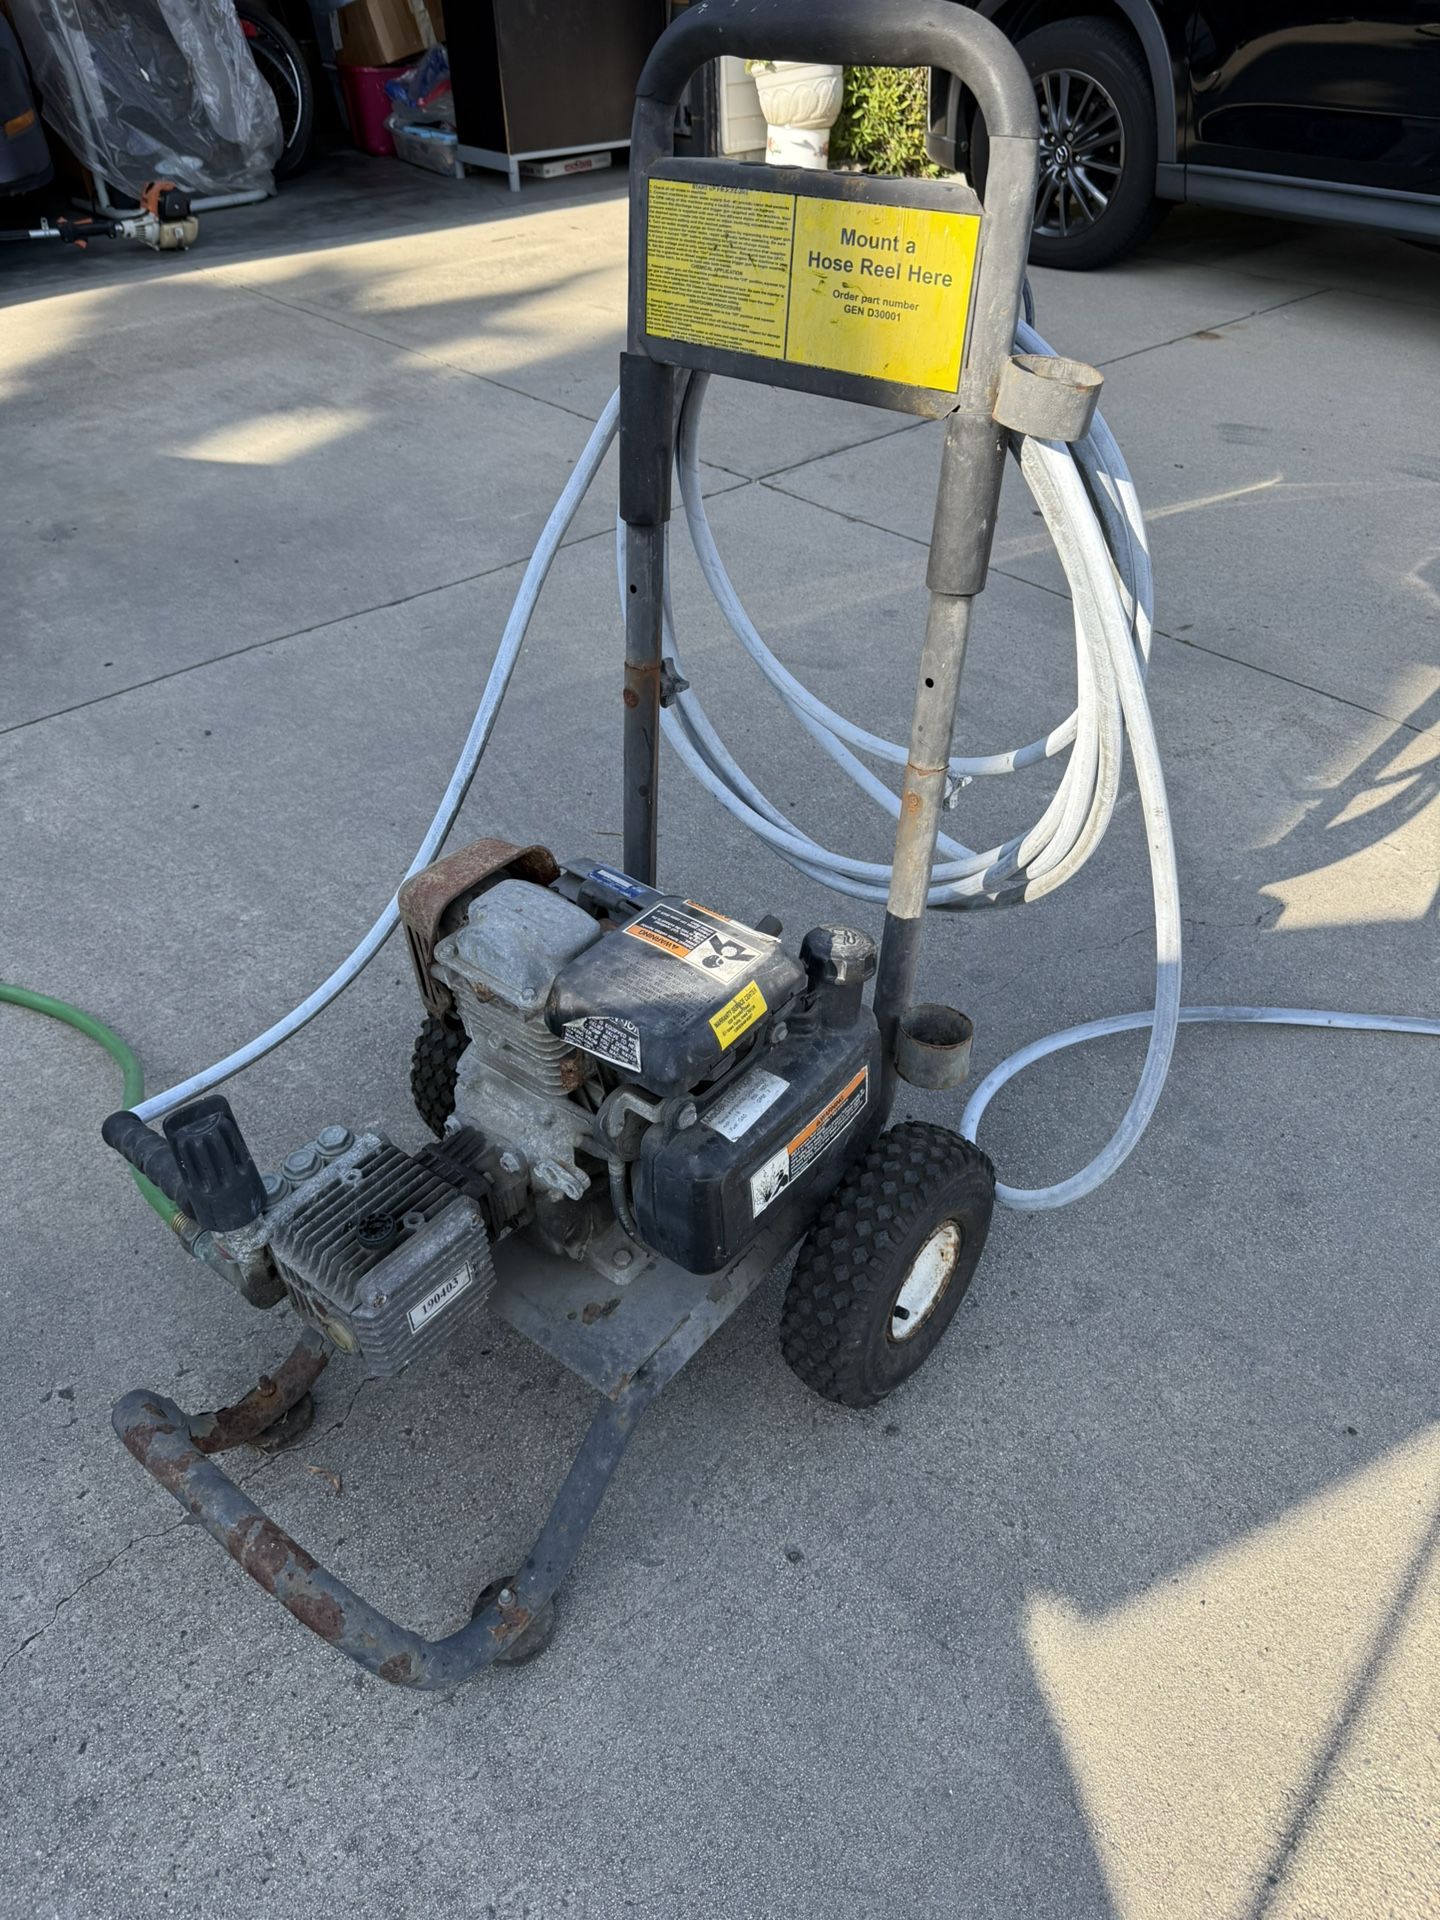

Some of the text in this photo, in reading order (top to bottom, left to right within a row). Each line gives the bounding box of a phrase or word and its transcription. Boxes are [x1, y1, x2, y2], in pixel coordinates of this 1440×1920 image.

[840, 227, 916, 254] Mount a
[808, 250, 953, 287] Hose Reel Here
[832, 289, 919, 311] Order part number
[844, 304, 901, 322] GEN D30001
[639, 929, 674, 949] WARNING
[714, 1010, 732, 1028] WARRANTY
[605, 1023, 627, 1039] EQUIPPED
[422, 1277, 459, 1315] 190403
